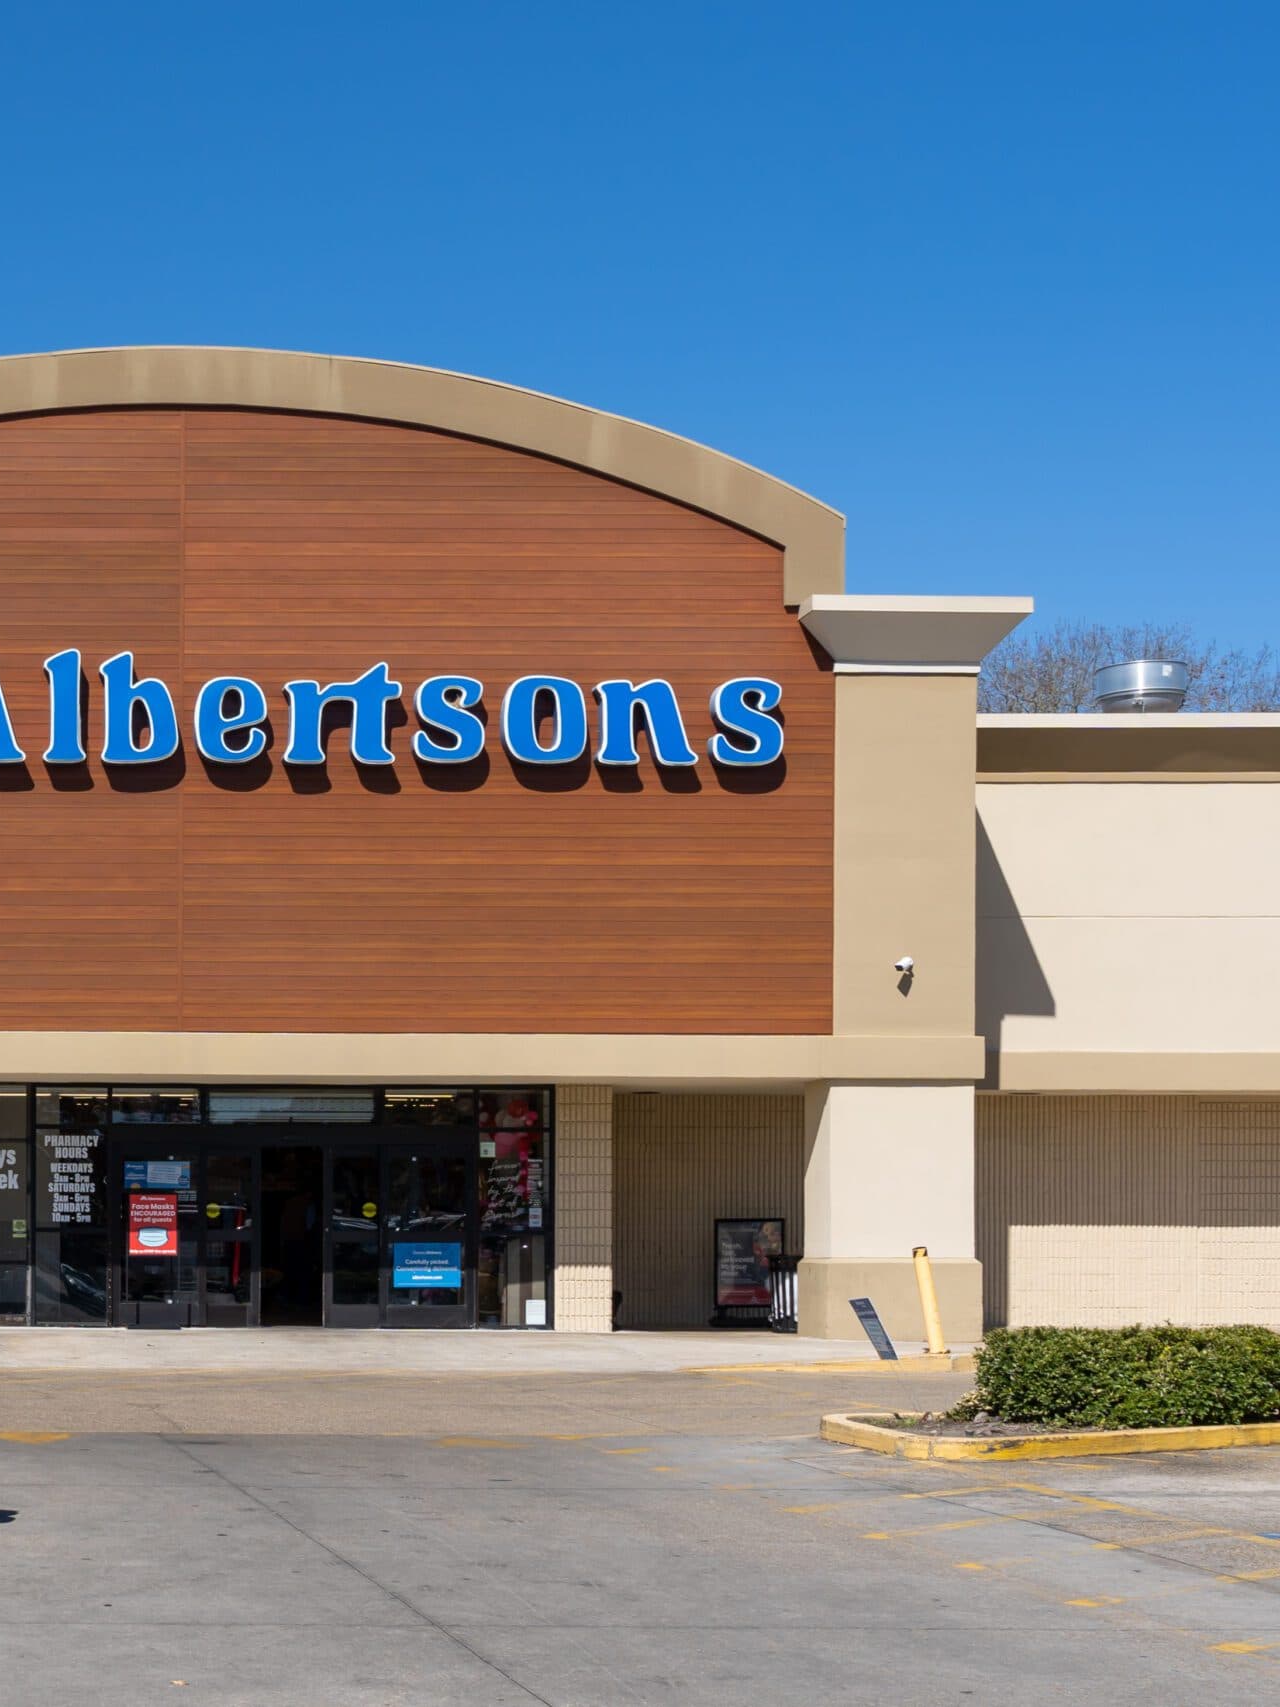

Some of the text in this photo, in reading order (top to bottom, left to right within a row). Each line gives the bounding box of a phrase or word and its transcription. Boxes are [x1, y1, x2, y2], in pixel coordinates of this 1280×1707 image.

[44, 1134, 99, 1147] PHARMACY
[54, 1147, 89, 1159] HOURS
[50, 1162, 94, 1173] WEEKDAYS
[47, 1182, 96, 1193] SATURDAYS
[52, 1202, 90, 1213] SUNDAYS
